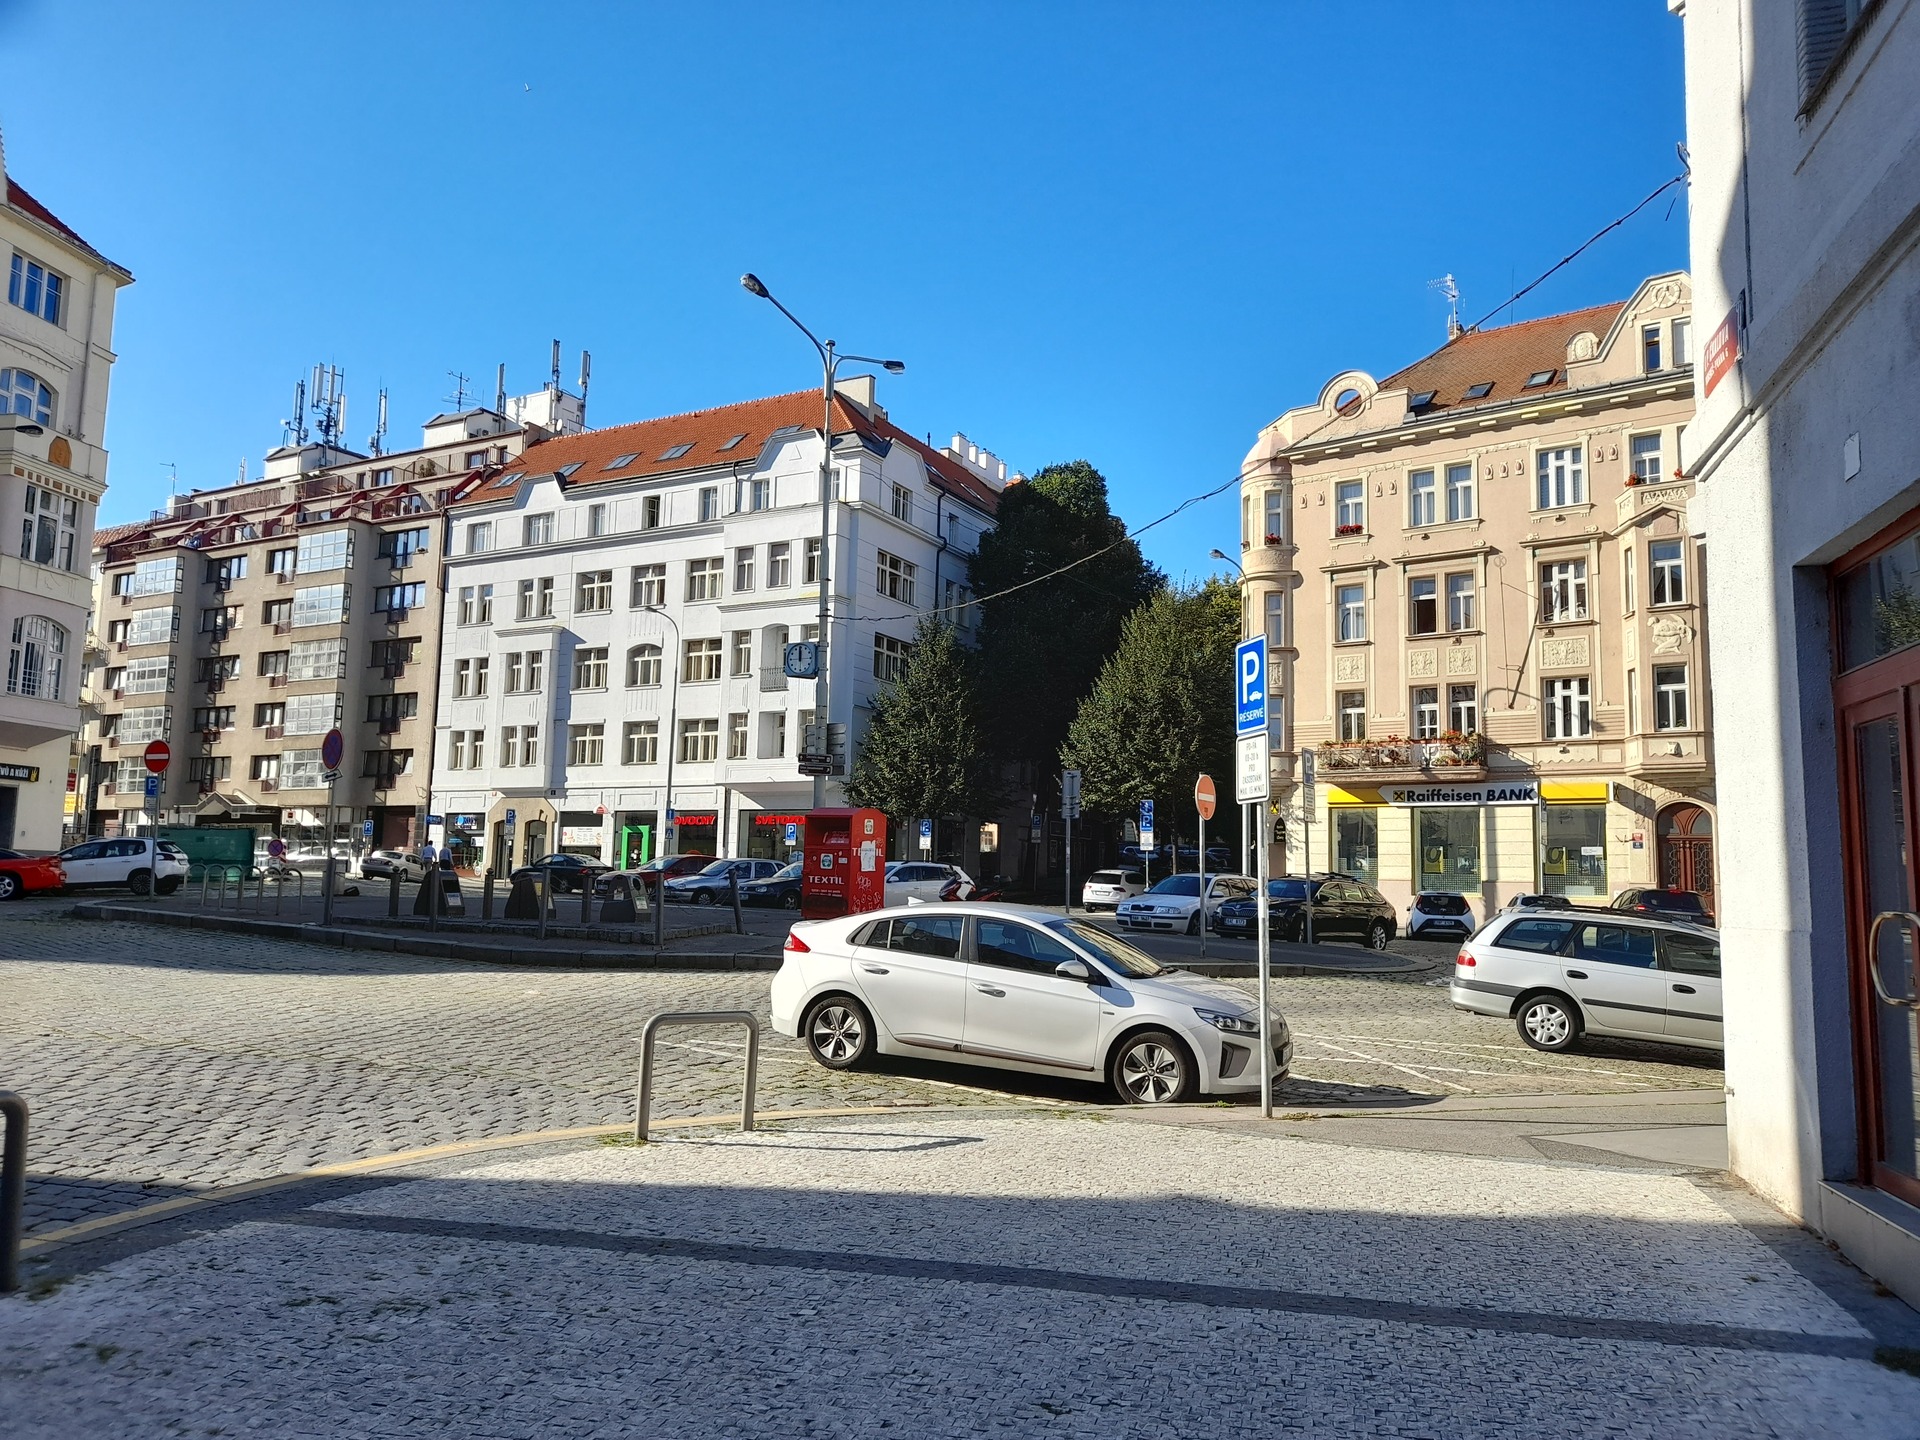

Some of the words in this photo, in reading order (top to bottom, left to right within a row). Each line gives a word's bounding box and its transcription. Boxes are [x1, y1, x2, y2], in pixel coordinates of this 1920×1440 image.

[1242, 651, 1260, 704] P
[1406, 789, 1482, 802] Raiffeisen
[1486, 789, 1536, 801] BANK
[852, 847, 884, 857] TEIL
[808, 875, 845, 885] TEXTIL
